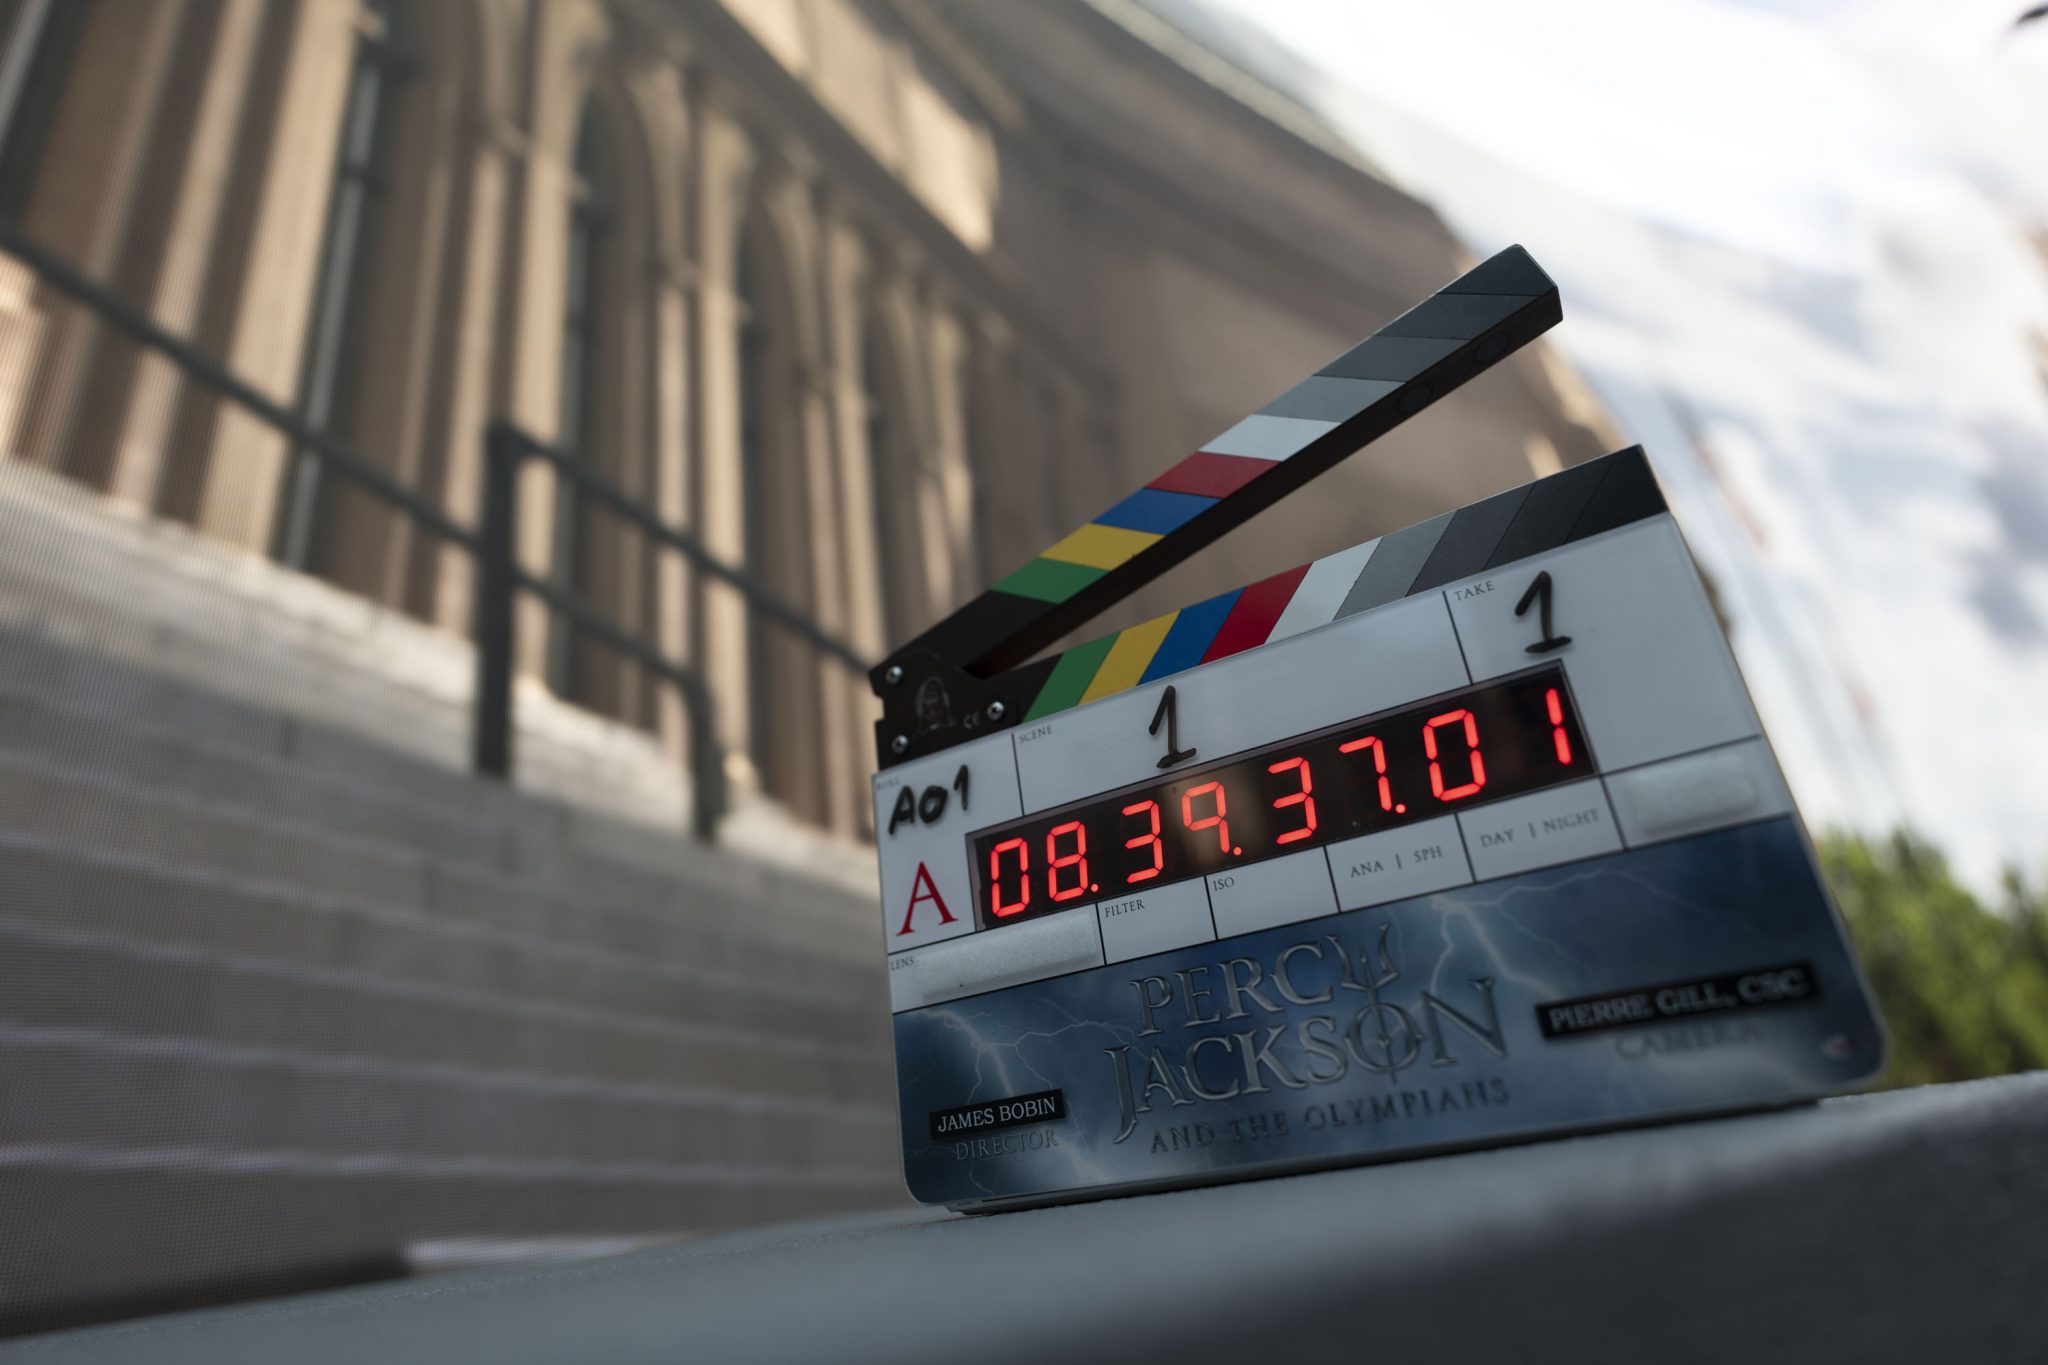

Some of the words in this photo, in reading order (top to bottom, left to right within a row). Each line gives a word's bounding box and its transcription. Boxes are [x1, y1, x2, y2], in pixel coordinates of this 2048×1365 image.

[1454, 580, 1495, 601] TAKE
[1514, 570, 1572, 654] 1
[1018, 724, 1053, 744] SCENE
[1149, 685, 1197, 768] 1
[1479, 828, 1515, 849] DAY
[1541, 807, 1600, 833] NIGHT
[1349, 860, 1385, 878] ANA
[1413, 845, 1444, 863] SPH
[896, 861, 959, 936] A
[1212, 876, 1236, 892] ISO
[1104, 898, 1145, 919] FILTER
[890, 956, 915, 972] LENS
[1130, 922, 1400, 1038] PERCY
[1549, 993, 1653, 1032] PIERRE
[1655, 982, 1739, 1015] GILL,
[1737, 967, 1808, 1002] CSC
[1104, 975, 1509, 1144] JACKSON
[937, 1108, 995, 1132] JAMES
[999, 1096, 1056, 1122] BOBIN
[1151, 1121, 1216, 1155] AND
[1229, 1110, 1291, 1143] THE
[1303, 1077, 1511, 1131] OLYMPIANS
[955, 1128, 1059, 1161] DIRECTOR
